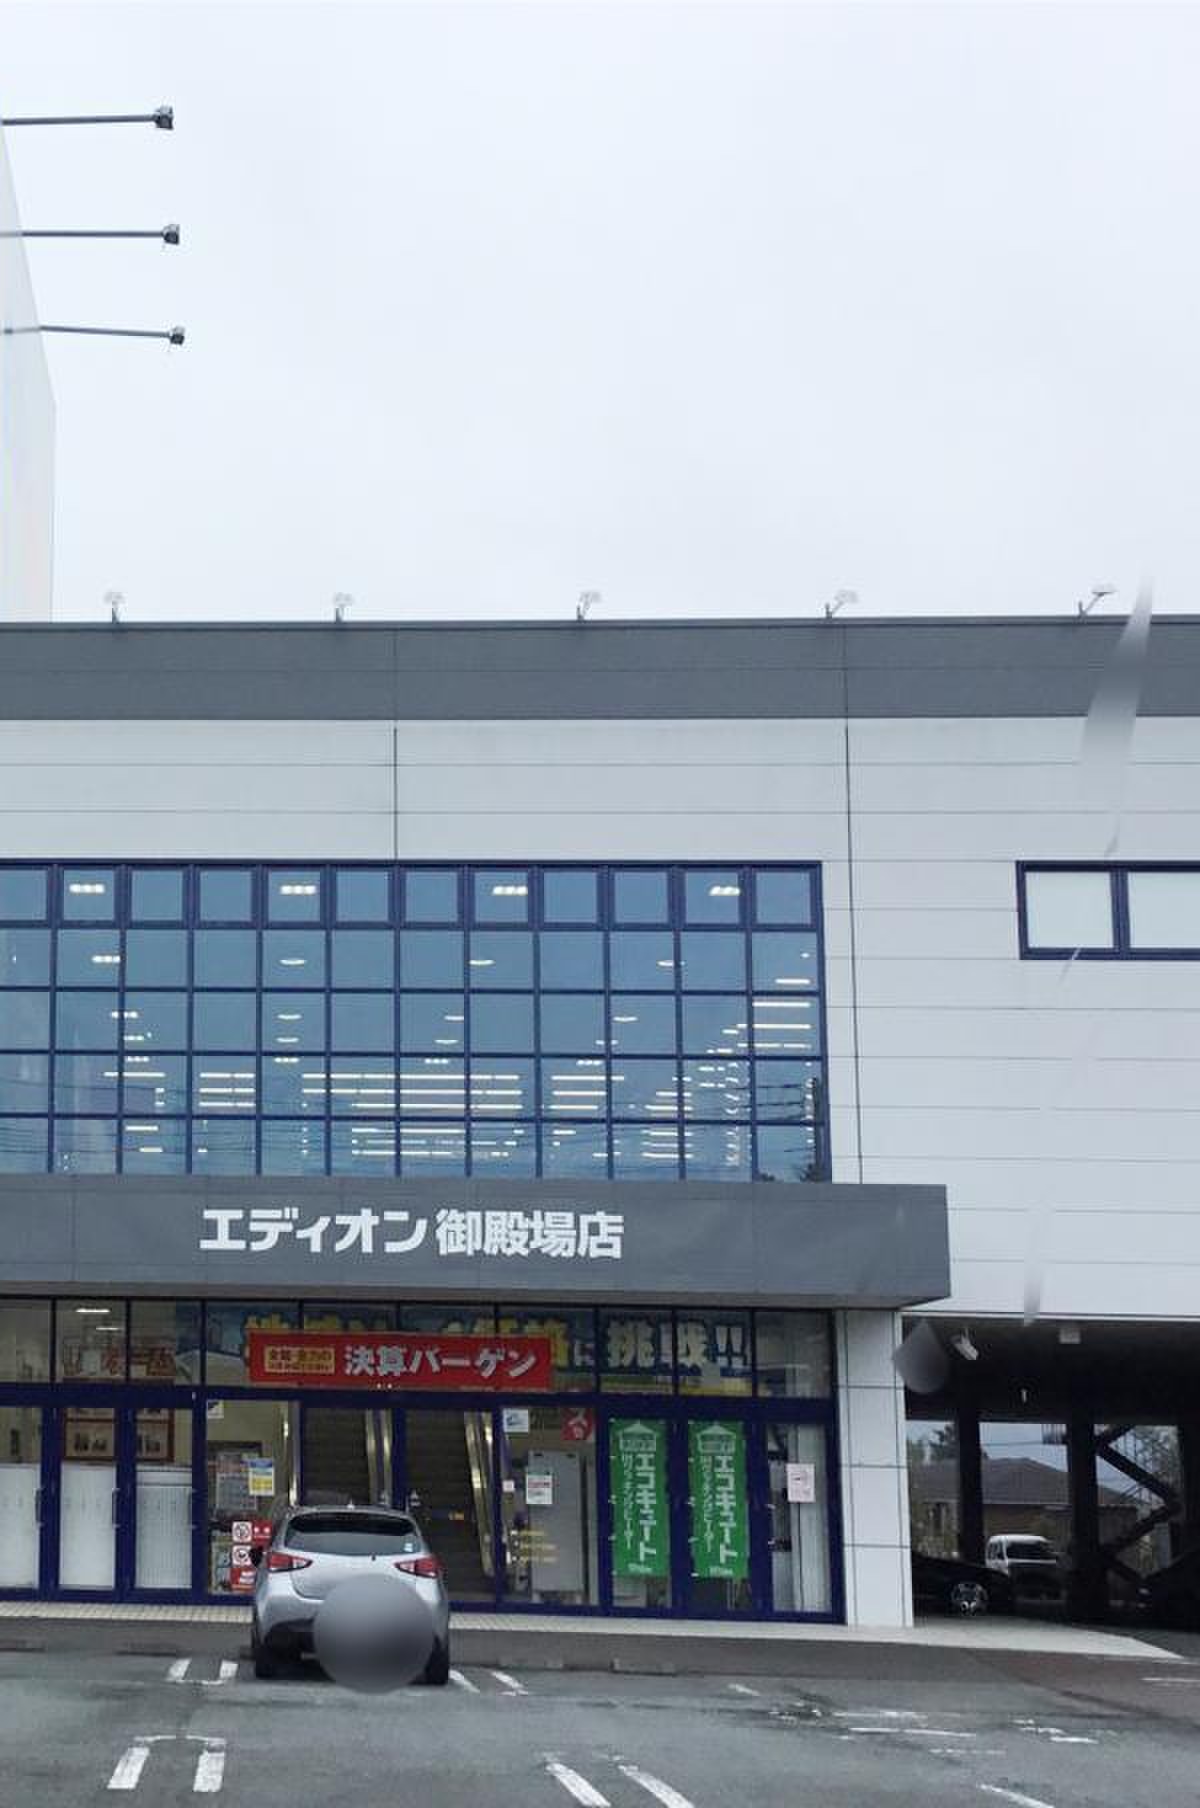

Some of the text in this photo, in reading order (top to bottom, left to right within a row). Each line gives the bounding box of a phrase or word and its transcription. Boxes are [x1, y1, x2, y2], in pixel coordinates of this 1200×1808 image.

[200, 1207, 626, 1259] エディオン御殿場店
[344, 1346, 537, 1378] 決算バーゲン
